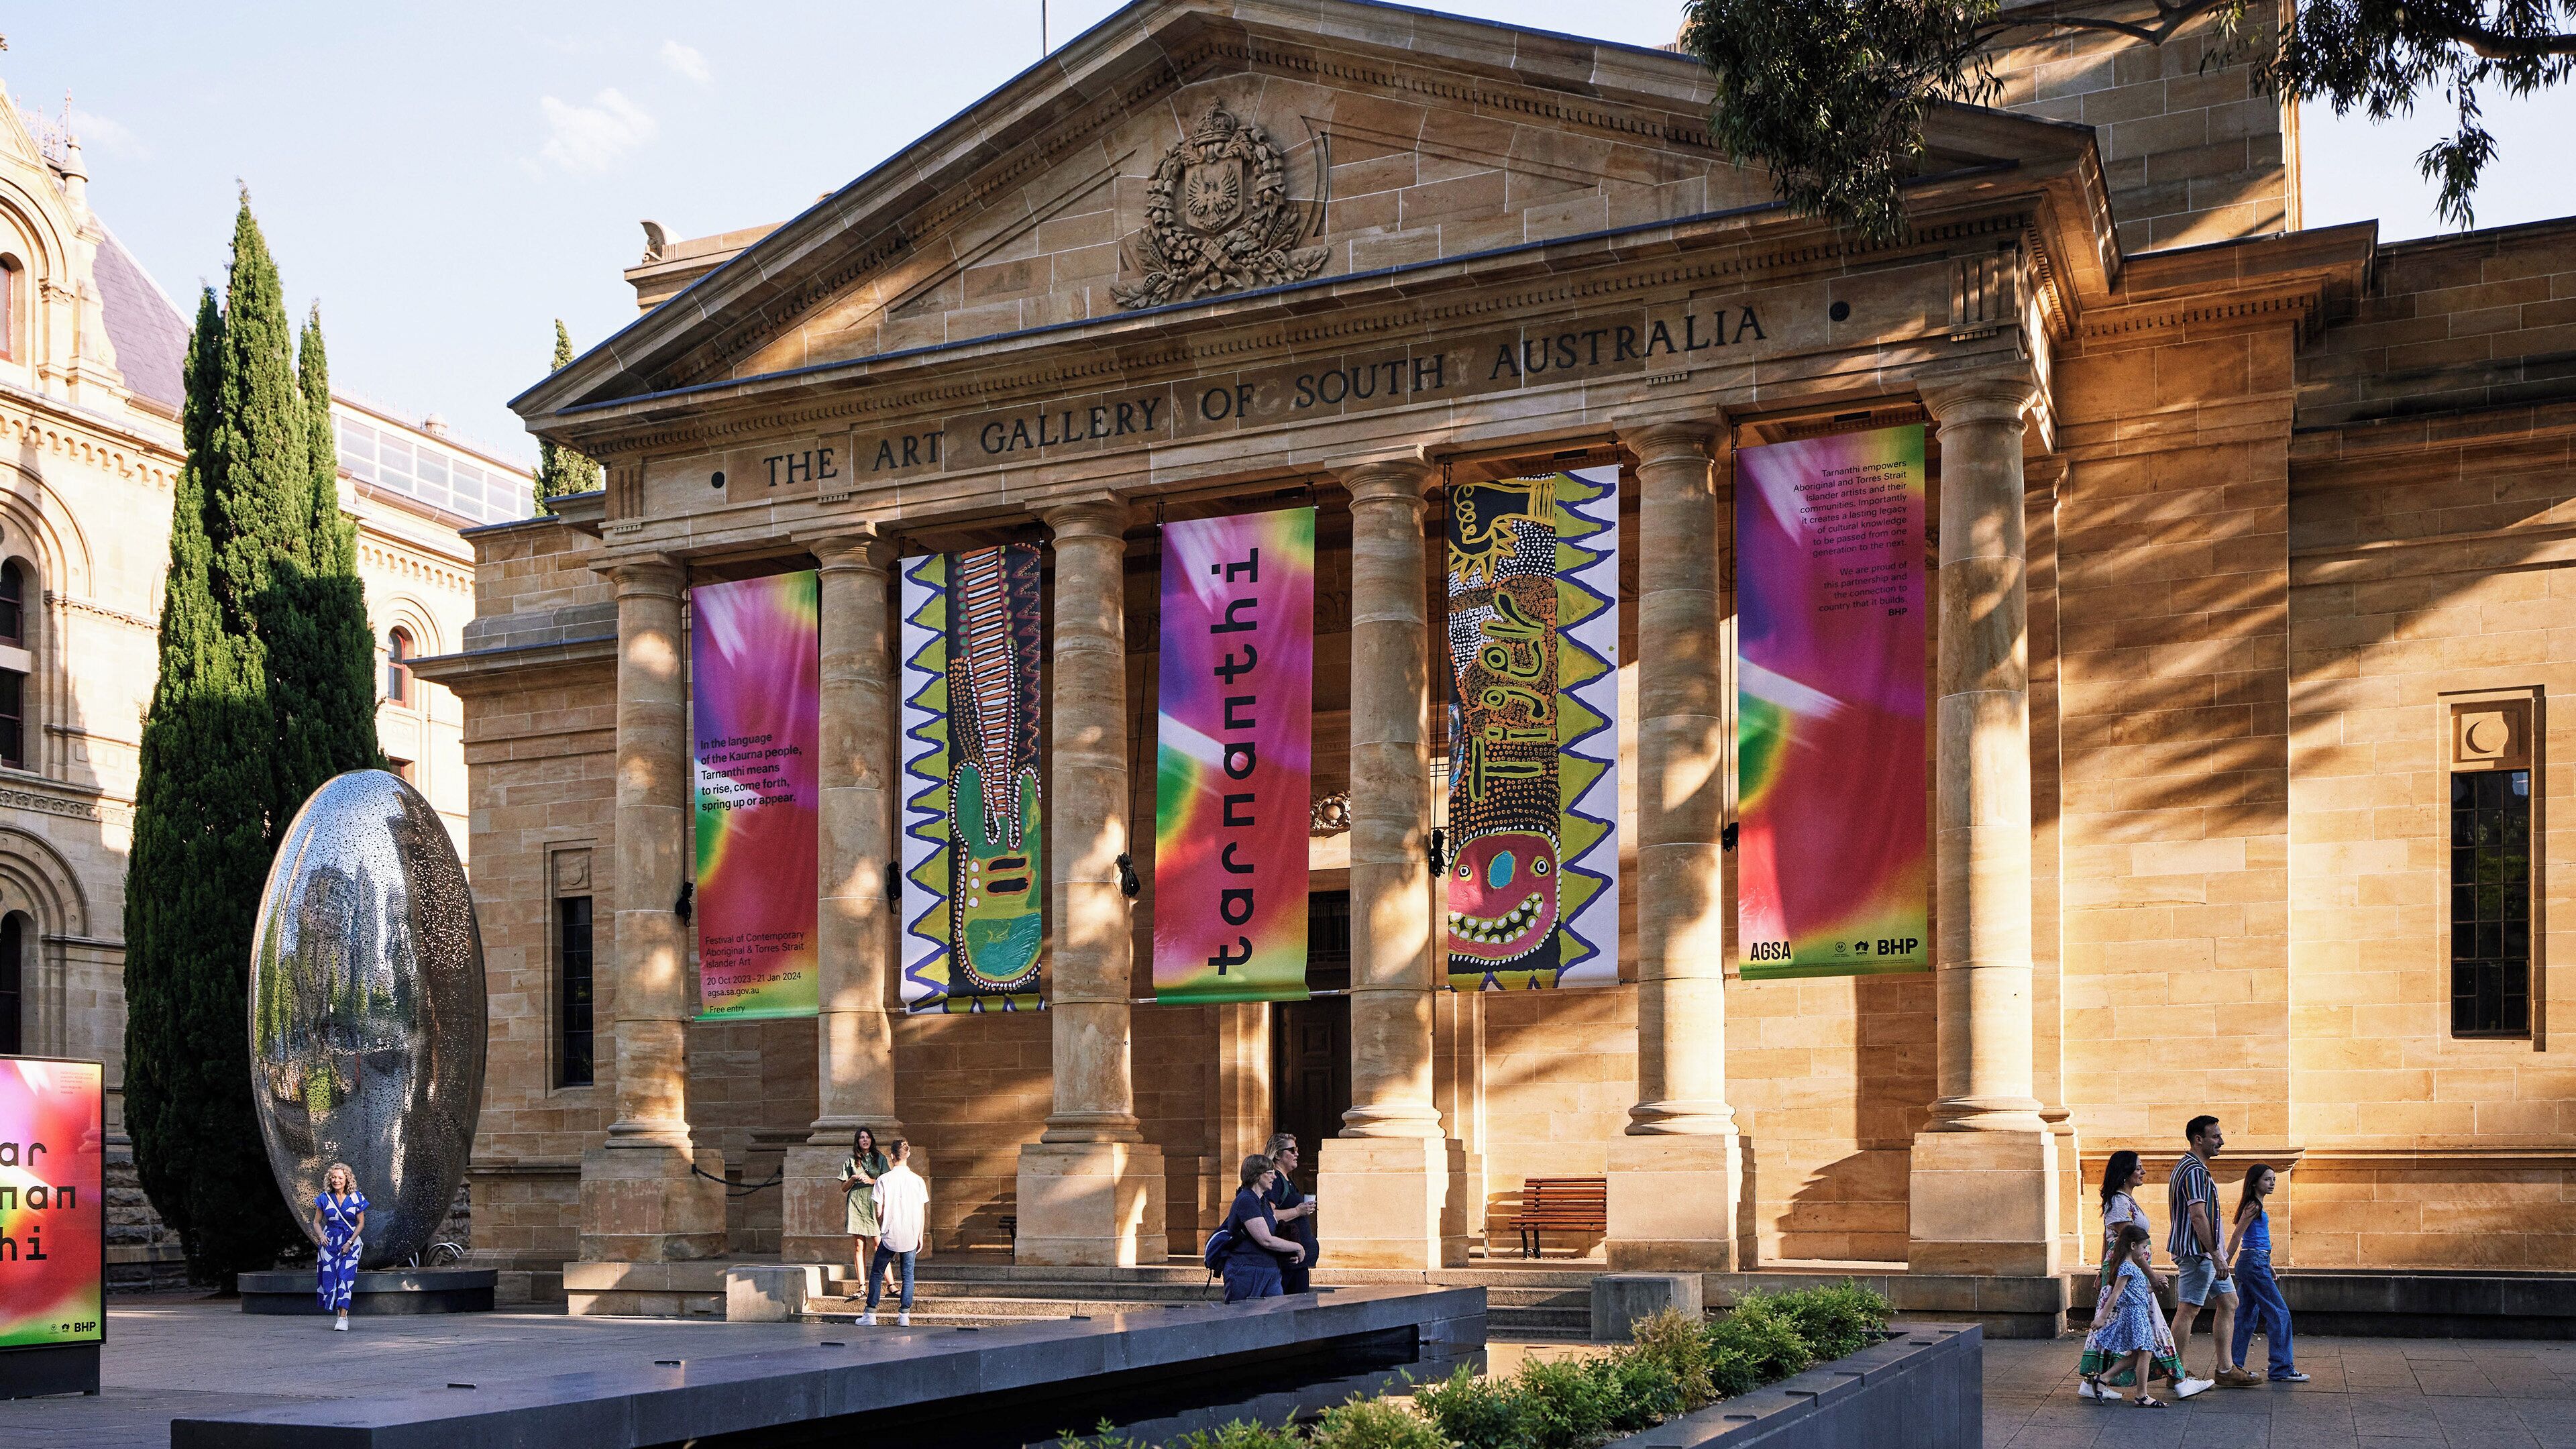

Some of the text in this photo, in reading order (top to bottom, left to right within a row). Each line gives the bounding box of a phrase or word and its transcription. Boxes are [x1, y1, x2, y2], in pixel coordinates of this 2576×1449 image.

[763, 305, 1767, 487] THE ART GALLERY OF SOUTH AUSTRALIA
[1822, 461, 1907, 477] Tarnanthi empowers
[1793, 471, 1907, 492] Aboriginal and Torres Strait
[1806, 482, 1907, 502] Islander artists and their
[1800, 494, 1907, 513] communities. Importantly
[1809, 514, 1839, 523] creates
[1849, 509, 1876, 519] lasting
[1880, 505, 1907, 517] legacy
[1817, 517, 1907, 534] of cultural knowledge
[1824, 536, 1834, 544] be
[1837, 533, 1866, 544] passed
[1869, 531, 1888, 539] from
[1891, 528, 1907, 536] one
[1813, 539, 1907, 558] generation to the next.
[1840, 568, 1854, 576] We
[1872, 563, 1896, 573] proud
[1898, 561, 1907, 569] of
[1824, 573, 1907, 589] this partnership and
[1849, 586, 1896, 597] connection
[1819, 603, 1850, 612] country
[1872, 598, 1877, 606] it
[1880, 596, 1907, 604] builds.
[1888, 608, 1907, 616] BHP
[700, 734, 772, 750] In the language
[700, 745, 802, 765] of the Kaurna people,
[1208, 547, 1260, 975] tarnanthi
[702, 764, 780, 780] Tarnanthi means
[702, 777, 790, 796] to rise, come forth,
[702, 794, 796, 812] spring up or appear.
[706, 932, 804, 945] Festival of Contemporary
[1877, 938, 1919, 955] BHP
[706, 947, 744, 957] Aboriginal
[756, 944, 780, 953] Torres
[782, 943, 804, 951] Strait
[1750, 941, 1791, 961] AGSA
[706, 958, 735, 968] Islander
[718, 976, 731, 984] Oct
[783, 972, 801, 980] 2024
[708, 987, 759, 998] agsa.sa.gov.au
[727, 1005, 745, 1013] entry
[74, 1322, 96, 1332] BHP
